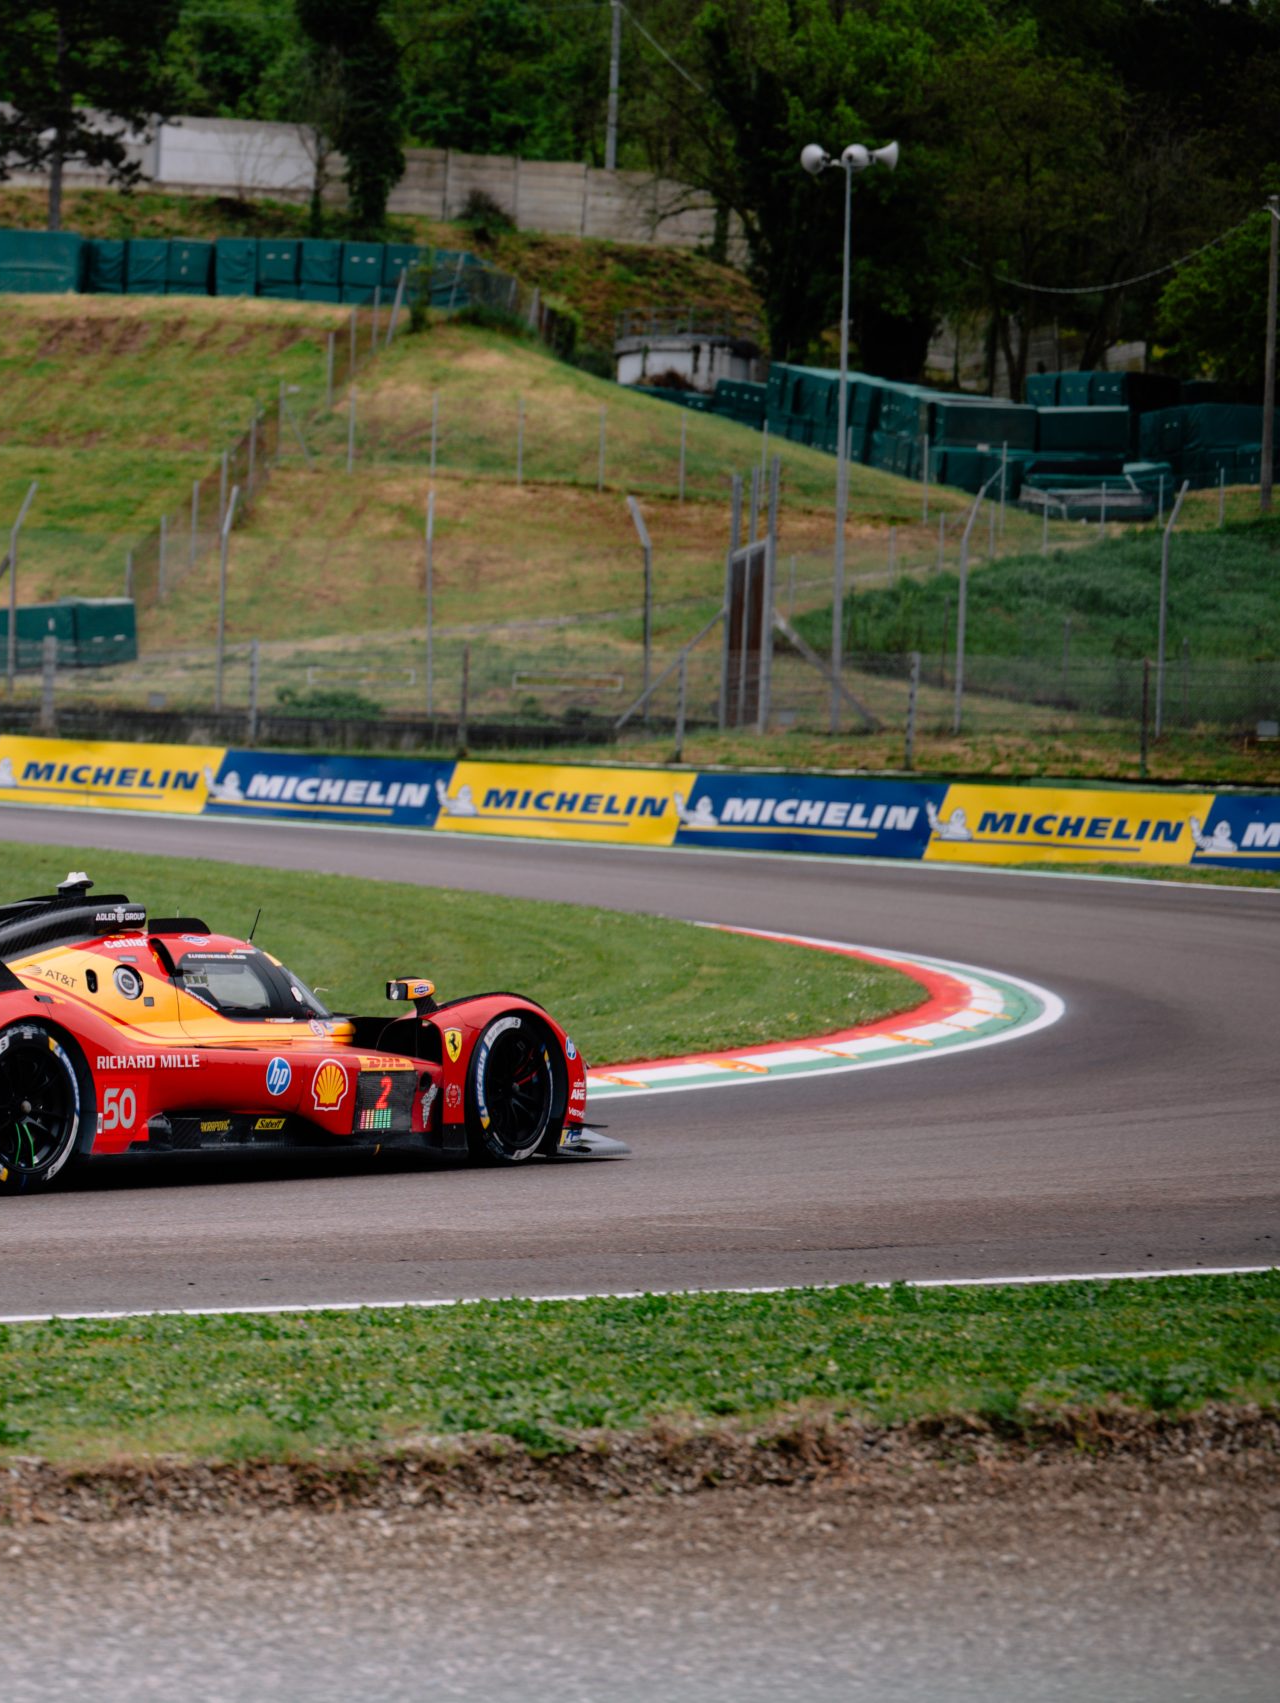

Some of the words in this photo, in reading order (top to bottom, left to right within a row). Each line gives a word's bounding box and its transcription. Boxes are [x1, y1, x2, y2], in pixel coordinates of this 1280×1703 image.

[21, 762, 200, 791] MICHELIN
[245, 774, 430, 808] MICHELIN
[482, 788, 669, 819] MICHELIN
[720, 797, 920, 831] MICHELIN
[977, 812, 1185, 843] MICHELIN
[95, 913, 116, 921] ADLER
[125, 912, 146, 921] GROUP
[45, 969, 78, 988] AT&T
[96, 1055, 156, 1070] RICHARD
[160, 1054, 200, 1068] MILLE
[268, 1058, 289, 1095] hp
[367, 1057, 407, 1068] DHL
[103, 1087, 137, 1130] 50
[375, 1076, 393, 1110] 2
